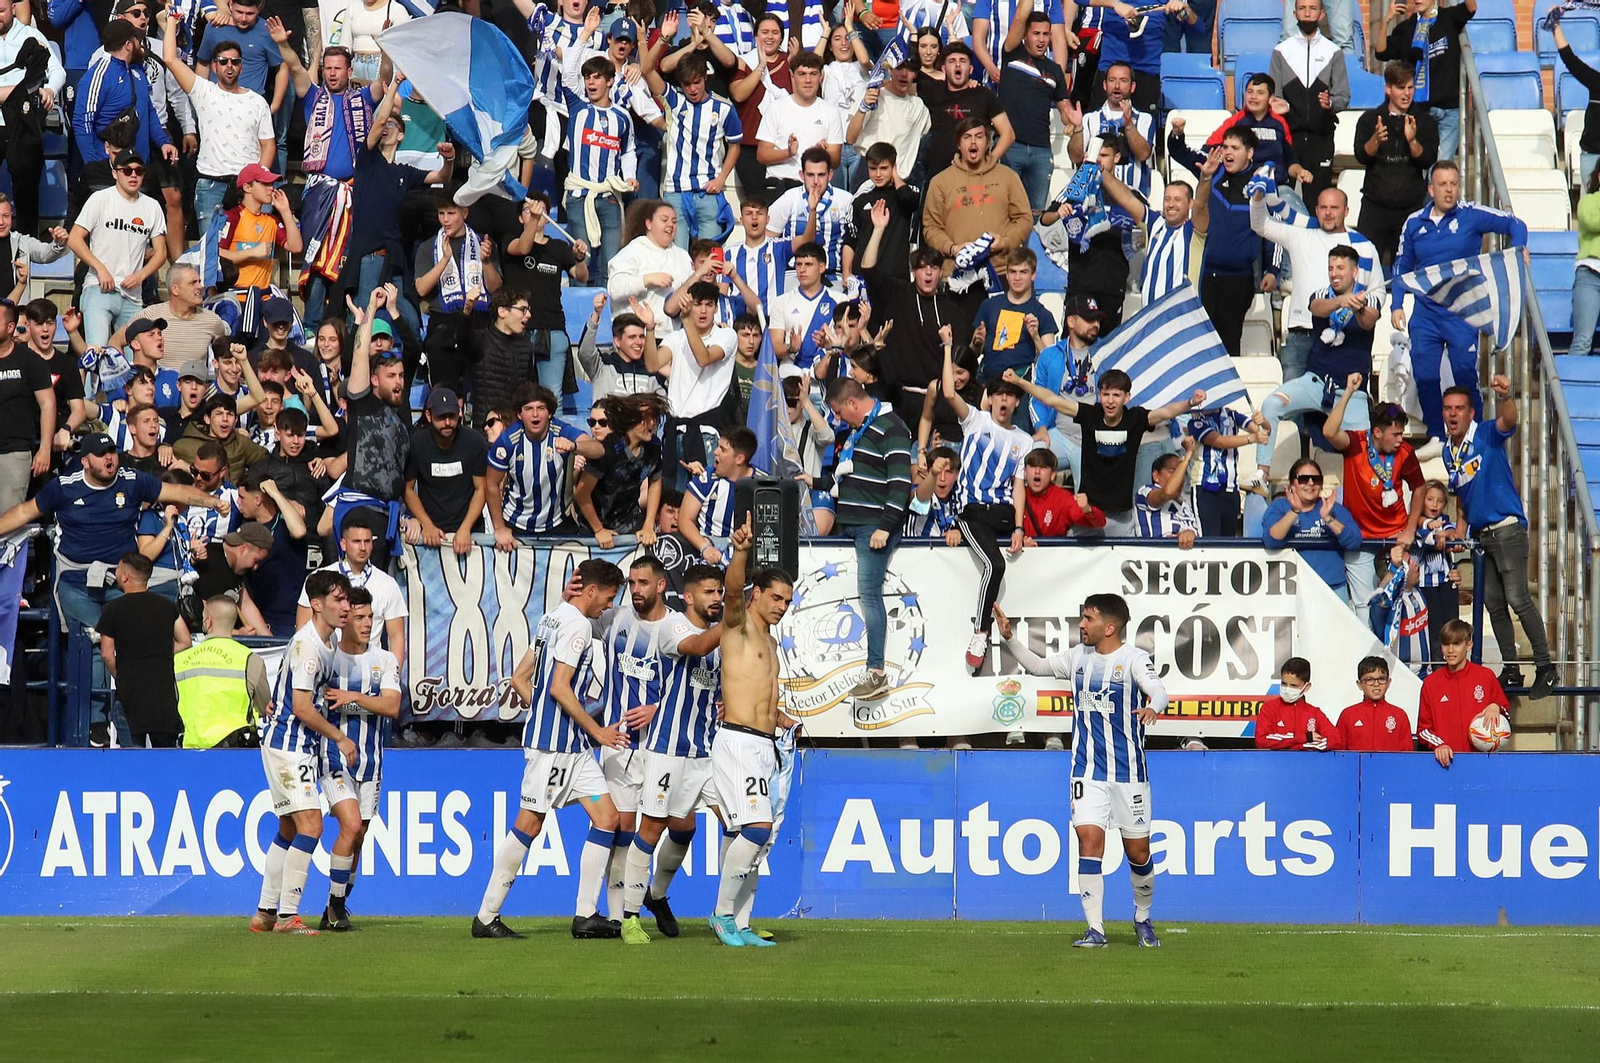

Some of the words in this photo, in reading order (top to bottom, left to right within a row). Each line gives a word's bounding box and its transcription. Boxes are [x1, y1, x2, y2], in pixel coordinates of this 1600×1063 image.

[315, 106, 327, 127] REAL
[105, 218, 151, 236] ellesse
[1121, 559, 1297, 596] SECTOR
[183, 646, 233, 666] SEGURIDAD
[971, 603, 1297, 681] HECÓST
[412, 676, 495, 713] Forza
[788, 688, 828, 709] Sector
[829, 667, 894, 698] Helicóo
[856, 704, 887, 722] Gol
[889, 694, 918, 715] Sur
[548, 767, 567, 787] 21
[658, 772, 670, 792] 4
[745, 777, 768, 796] 20
[40, 790, 474, 878] ATRACCNES
[1388, 802, 1600, 880] Hue
